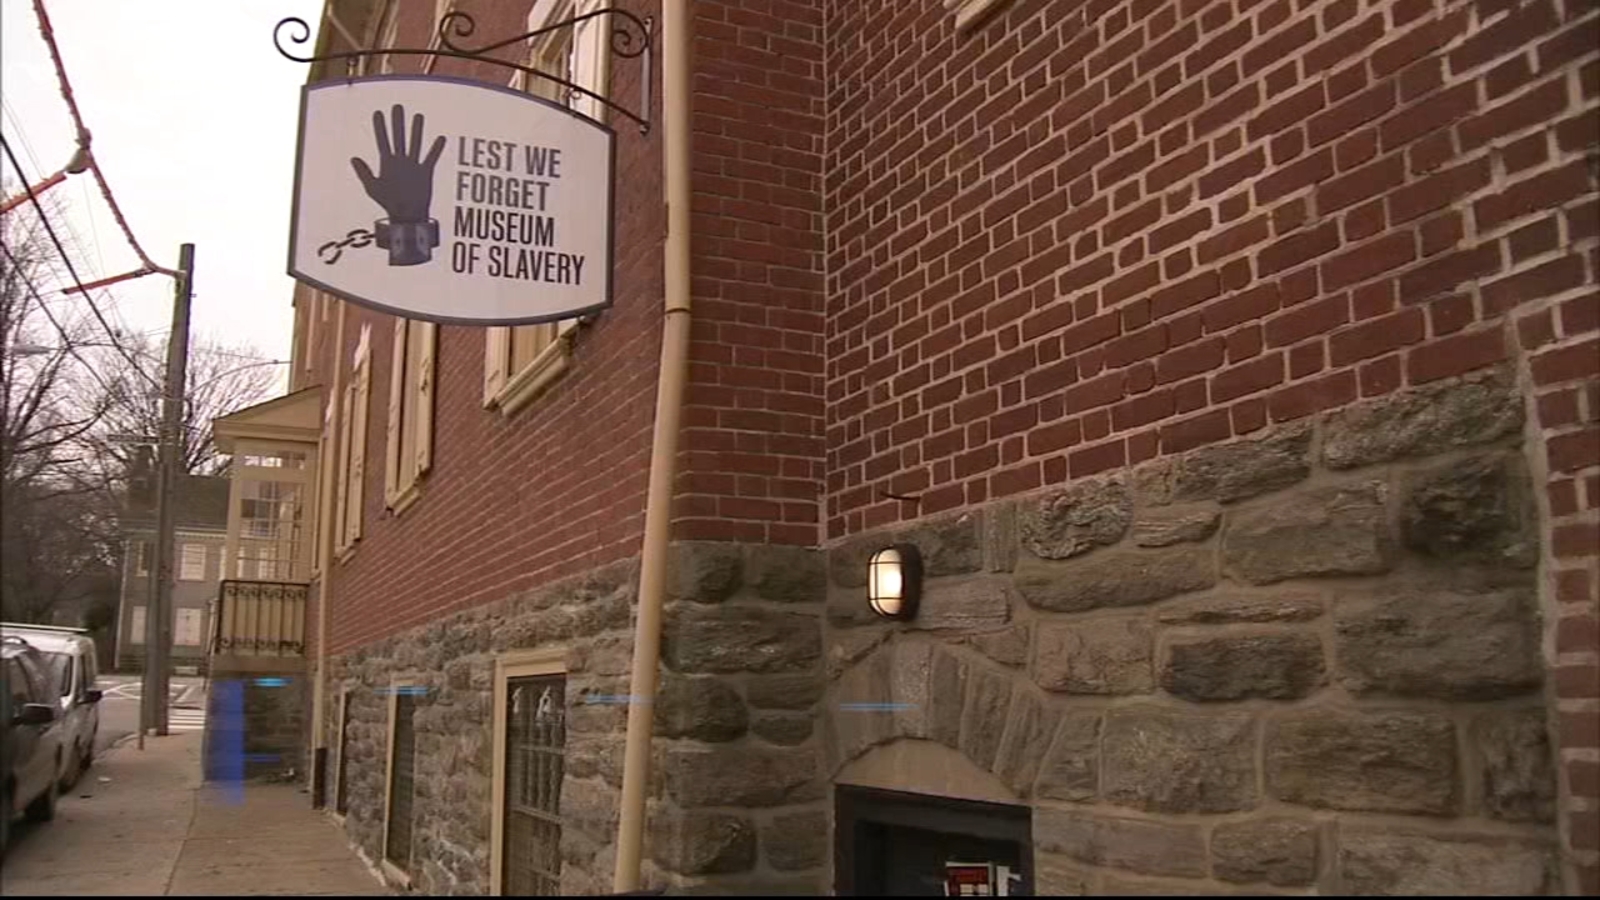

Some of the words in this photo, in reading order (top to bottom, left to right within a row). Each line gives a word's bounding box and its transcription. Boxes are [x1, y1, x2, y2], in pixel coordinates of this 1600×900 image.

[458, 136, 517, 172] LEST
[525, 145, 561, 178] WE
[456, 171, 550, 211] FORGET
[454, 206, 554, 247] MUSEUM
[452, 241, 480, 274] OF
[488, 246, 585, 285] SLAVERY
